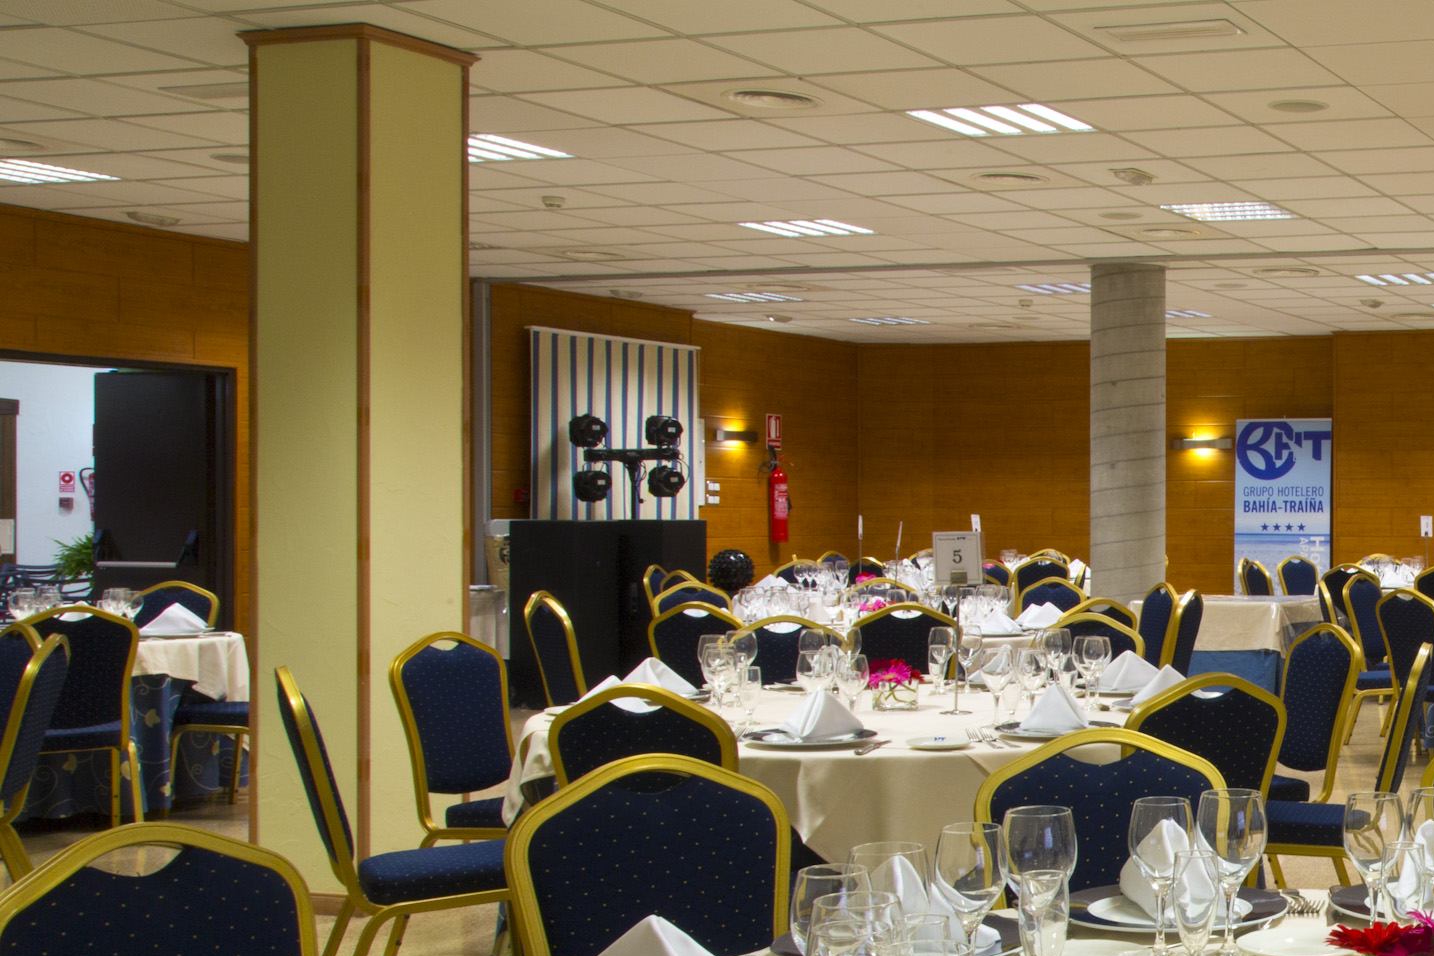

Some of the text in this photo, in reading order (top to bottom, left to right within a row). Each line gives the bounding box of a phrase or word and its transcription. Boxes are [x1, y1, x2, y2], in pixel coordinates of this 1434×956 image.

[1243, 486, 1324, 497] GRUPO HOTELERO
[1243, 498, 1324, 513] BAHÍA-TRAÍÑA
[952, 549, 963, 564] 5
